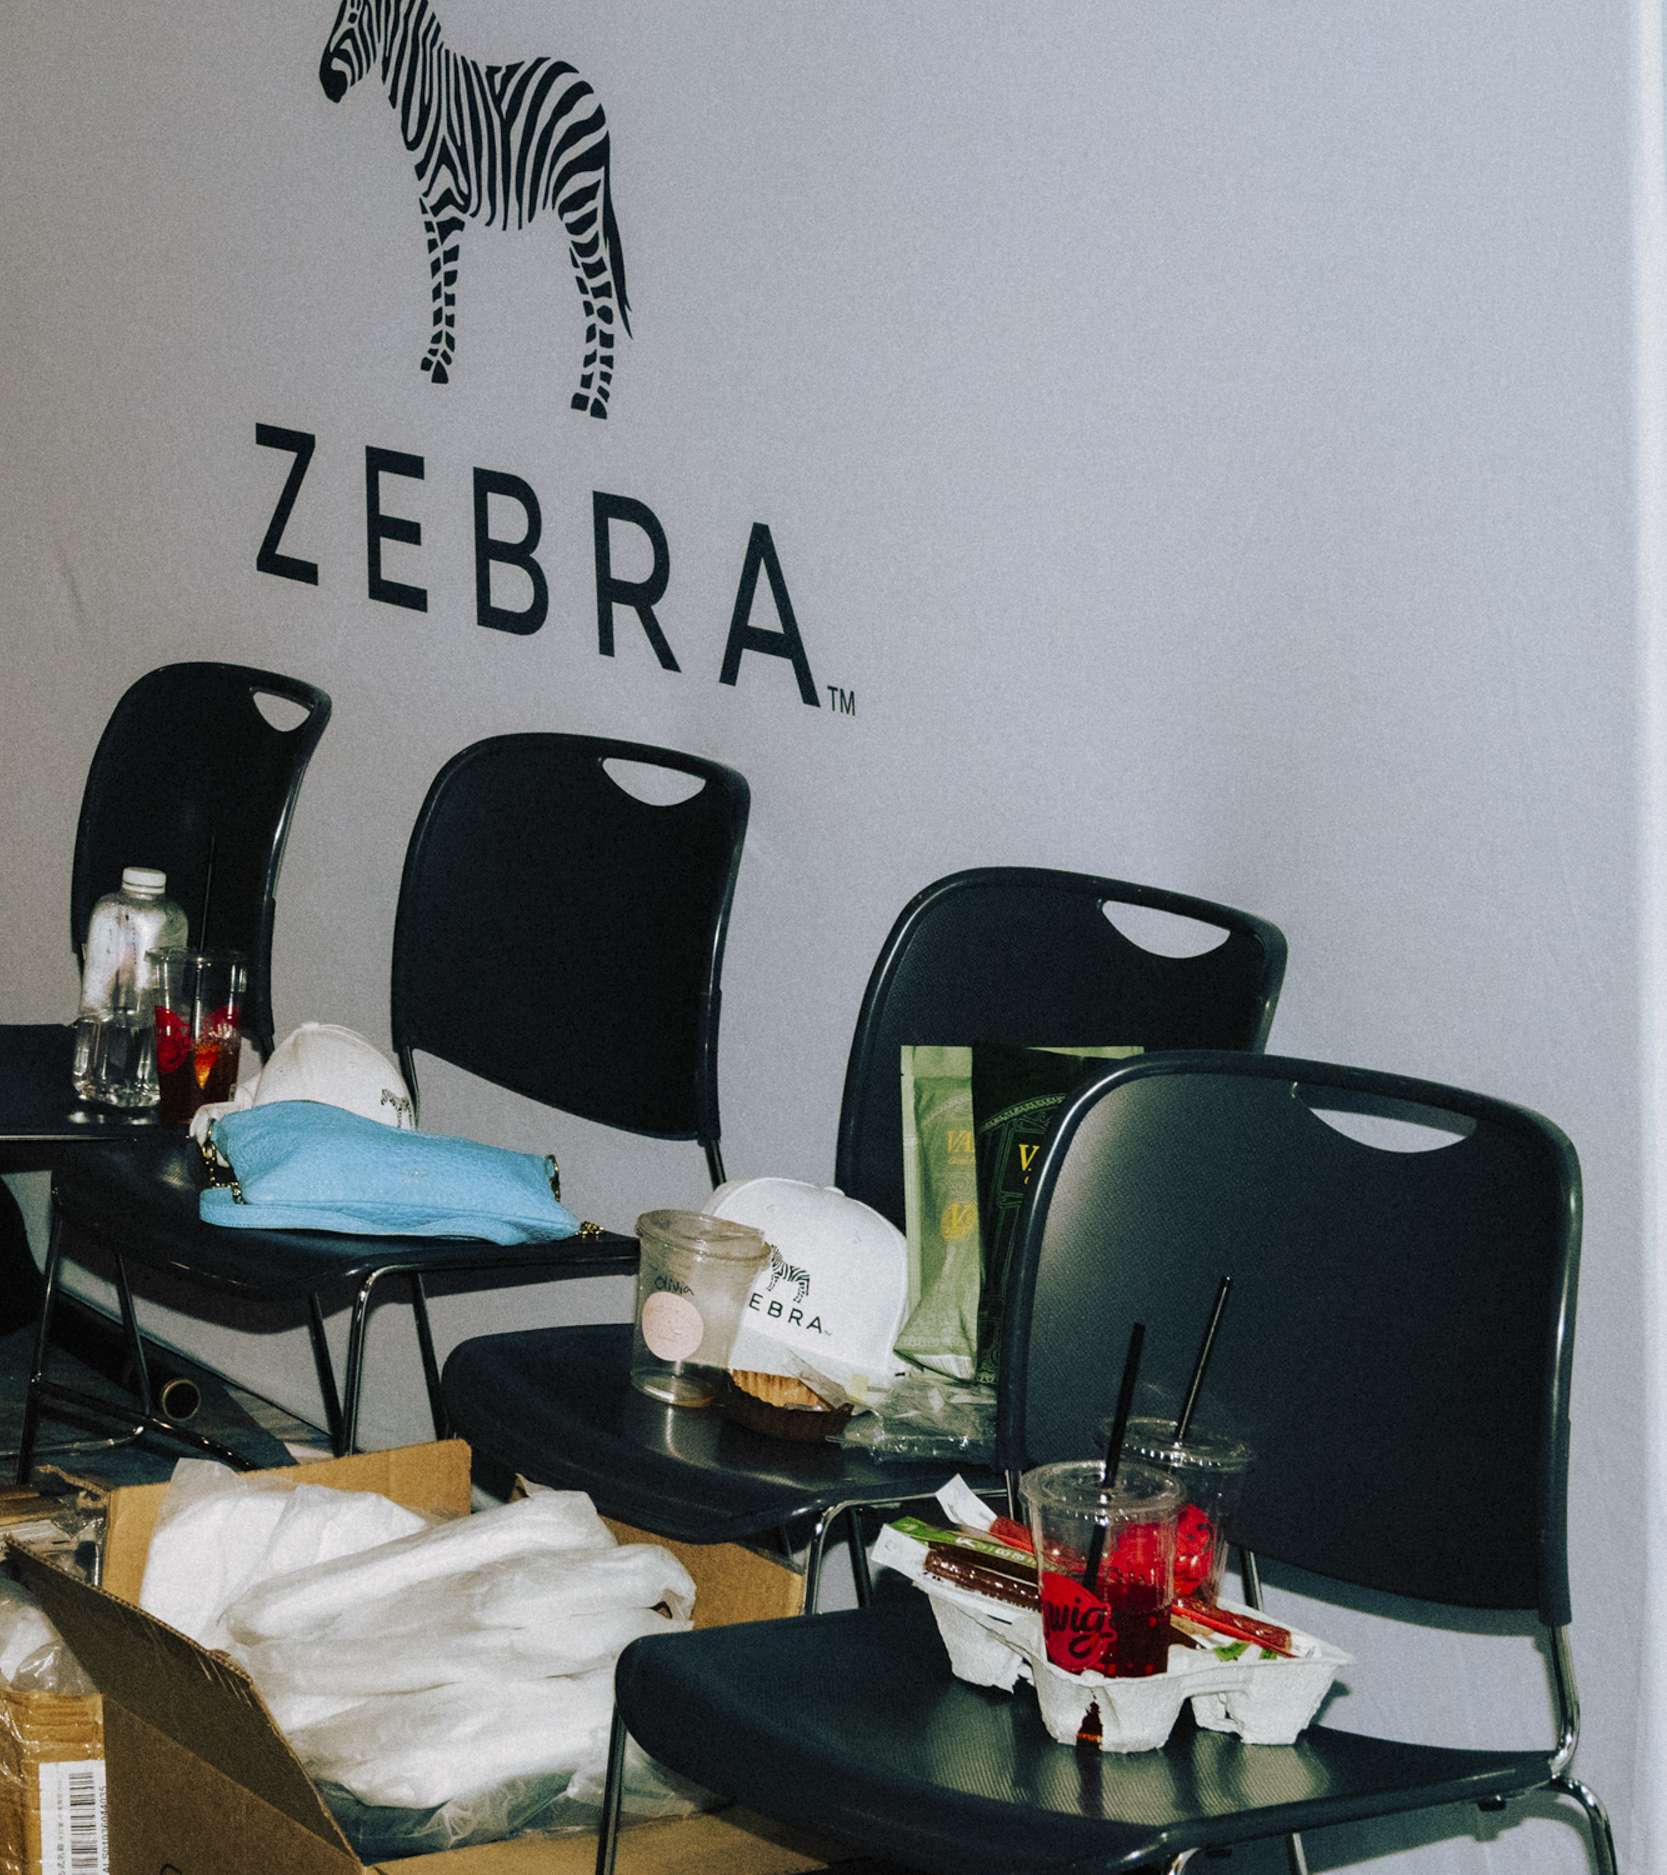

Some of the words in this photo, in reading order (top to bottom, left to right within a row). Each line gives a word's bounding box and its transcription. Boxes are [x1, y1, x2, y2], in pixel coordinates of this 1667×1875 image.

[255, 422, 821, 708] ZEBRA
[748, 1292, 822, 1334] EBRA
[1045, 1596, 1117, 1659] wig
